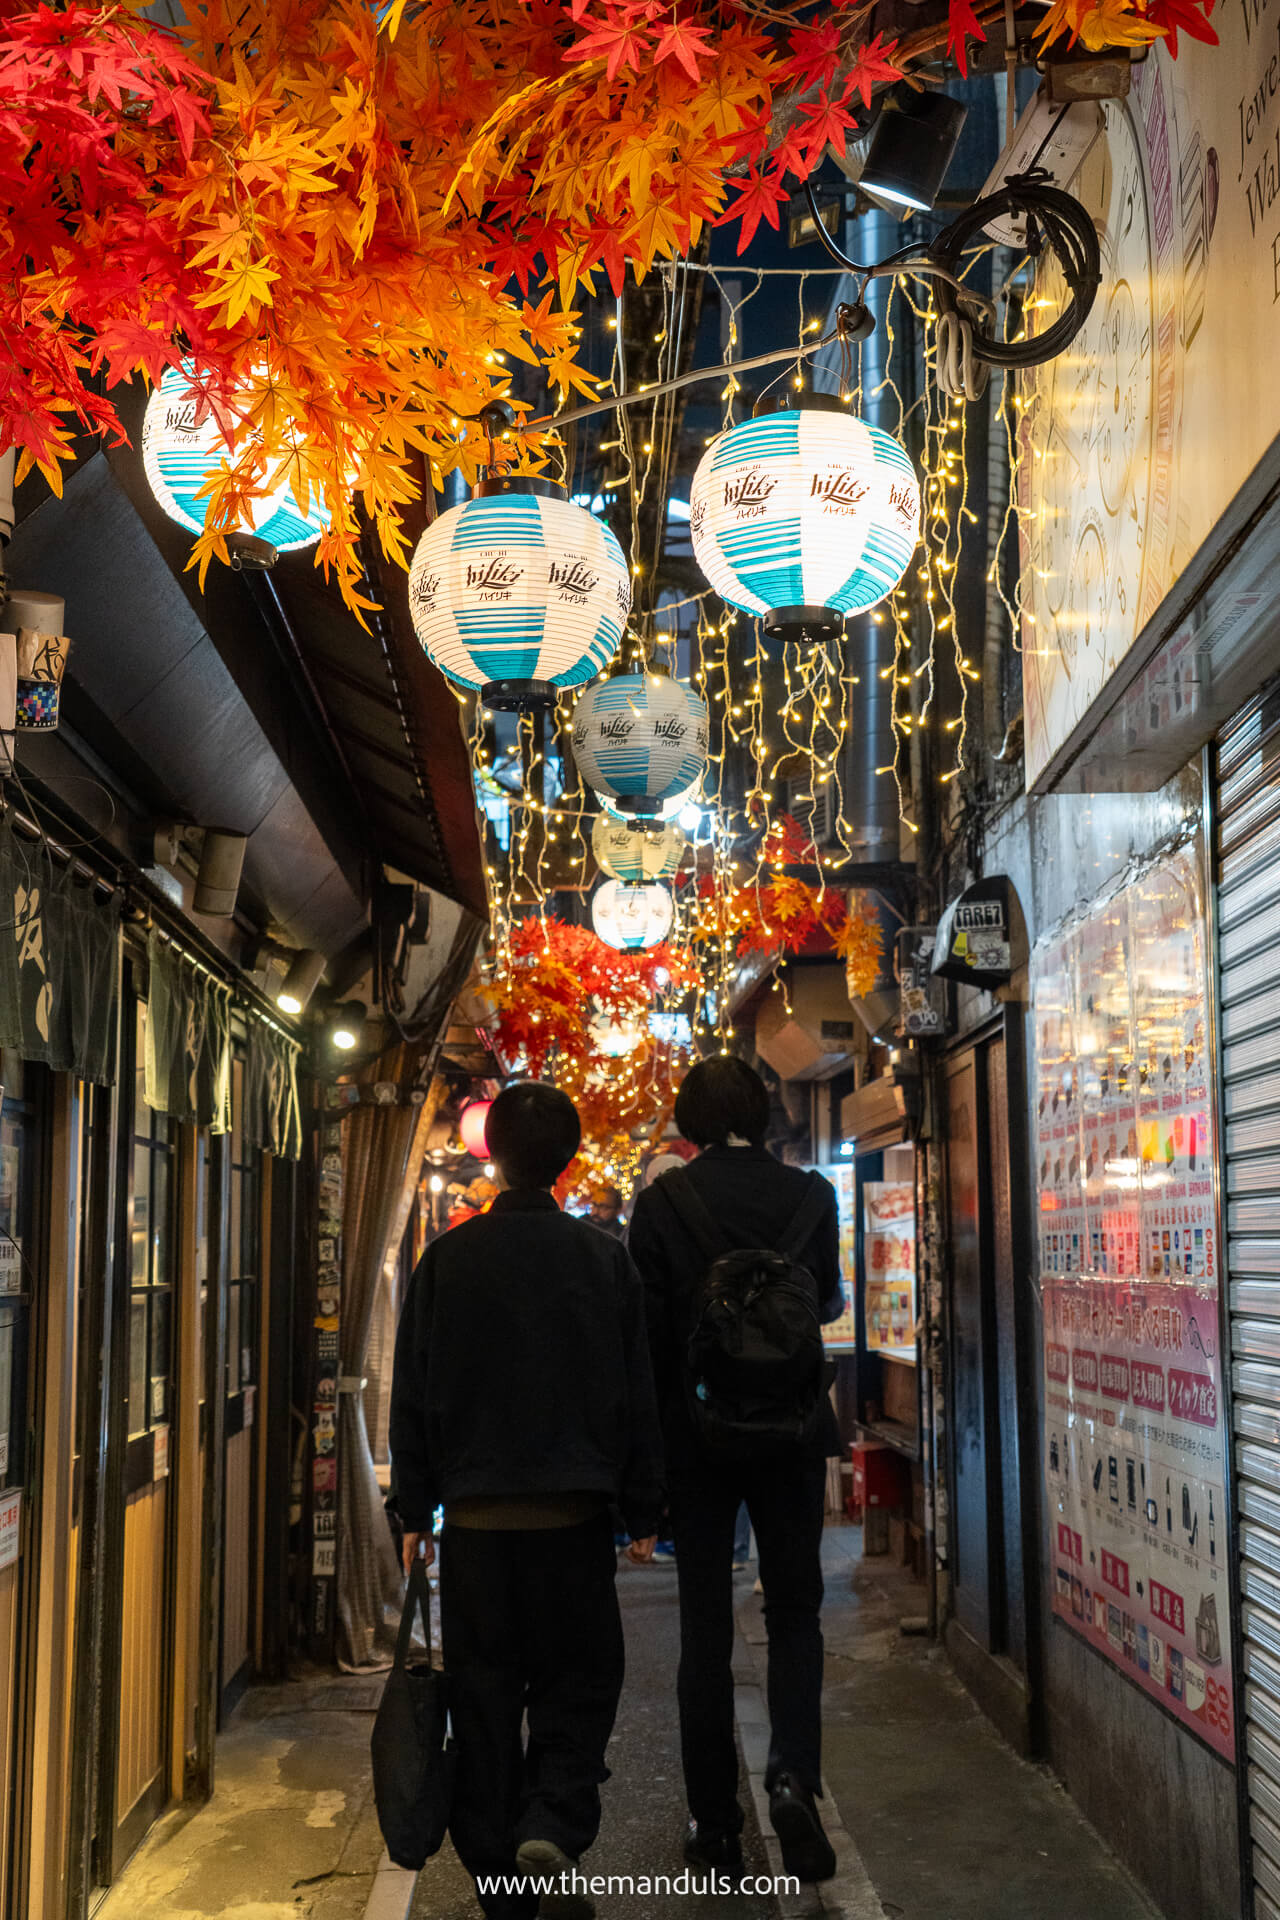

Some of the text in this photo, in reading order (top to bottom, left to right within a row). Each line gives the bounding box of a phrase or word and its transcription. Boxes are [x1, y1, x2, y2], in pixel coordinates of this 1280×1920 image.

[736, 504, 767, 520] ハイリキ
[822, 505, 857, 516] ハイリキ
[479, 591, 512, 601] ハイリキ
[558, 592, 588, 605] ハイリキ
